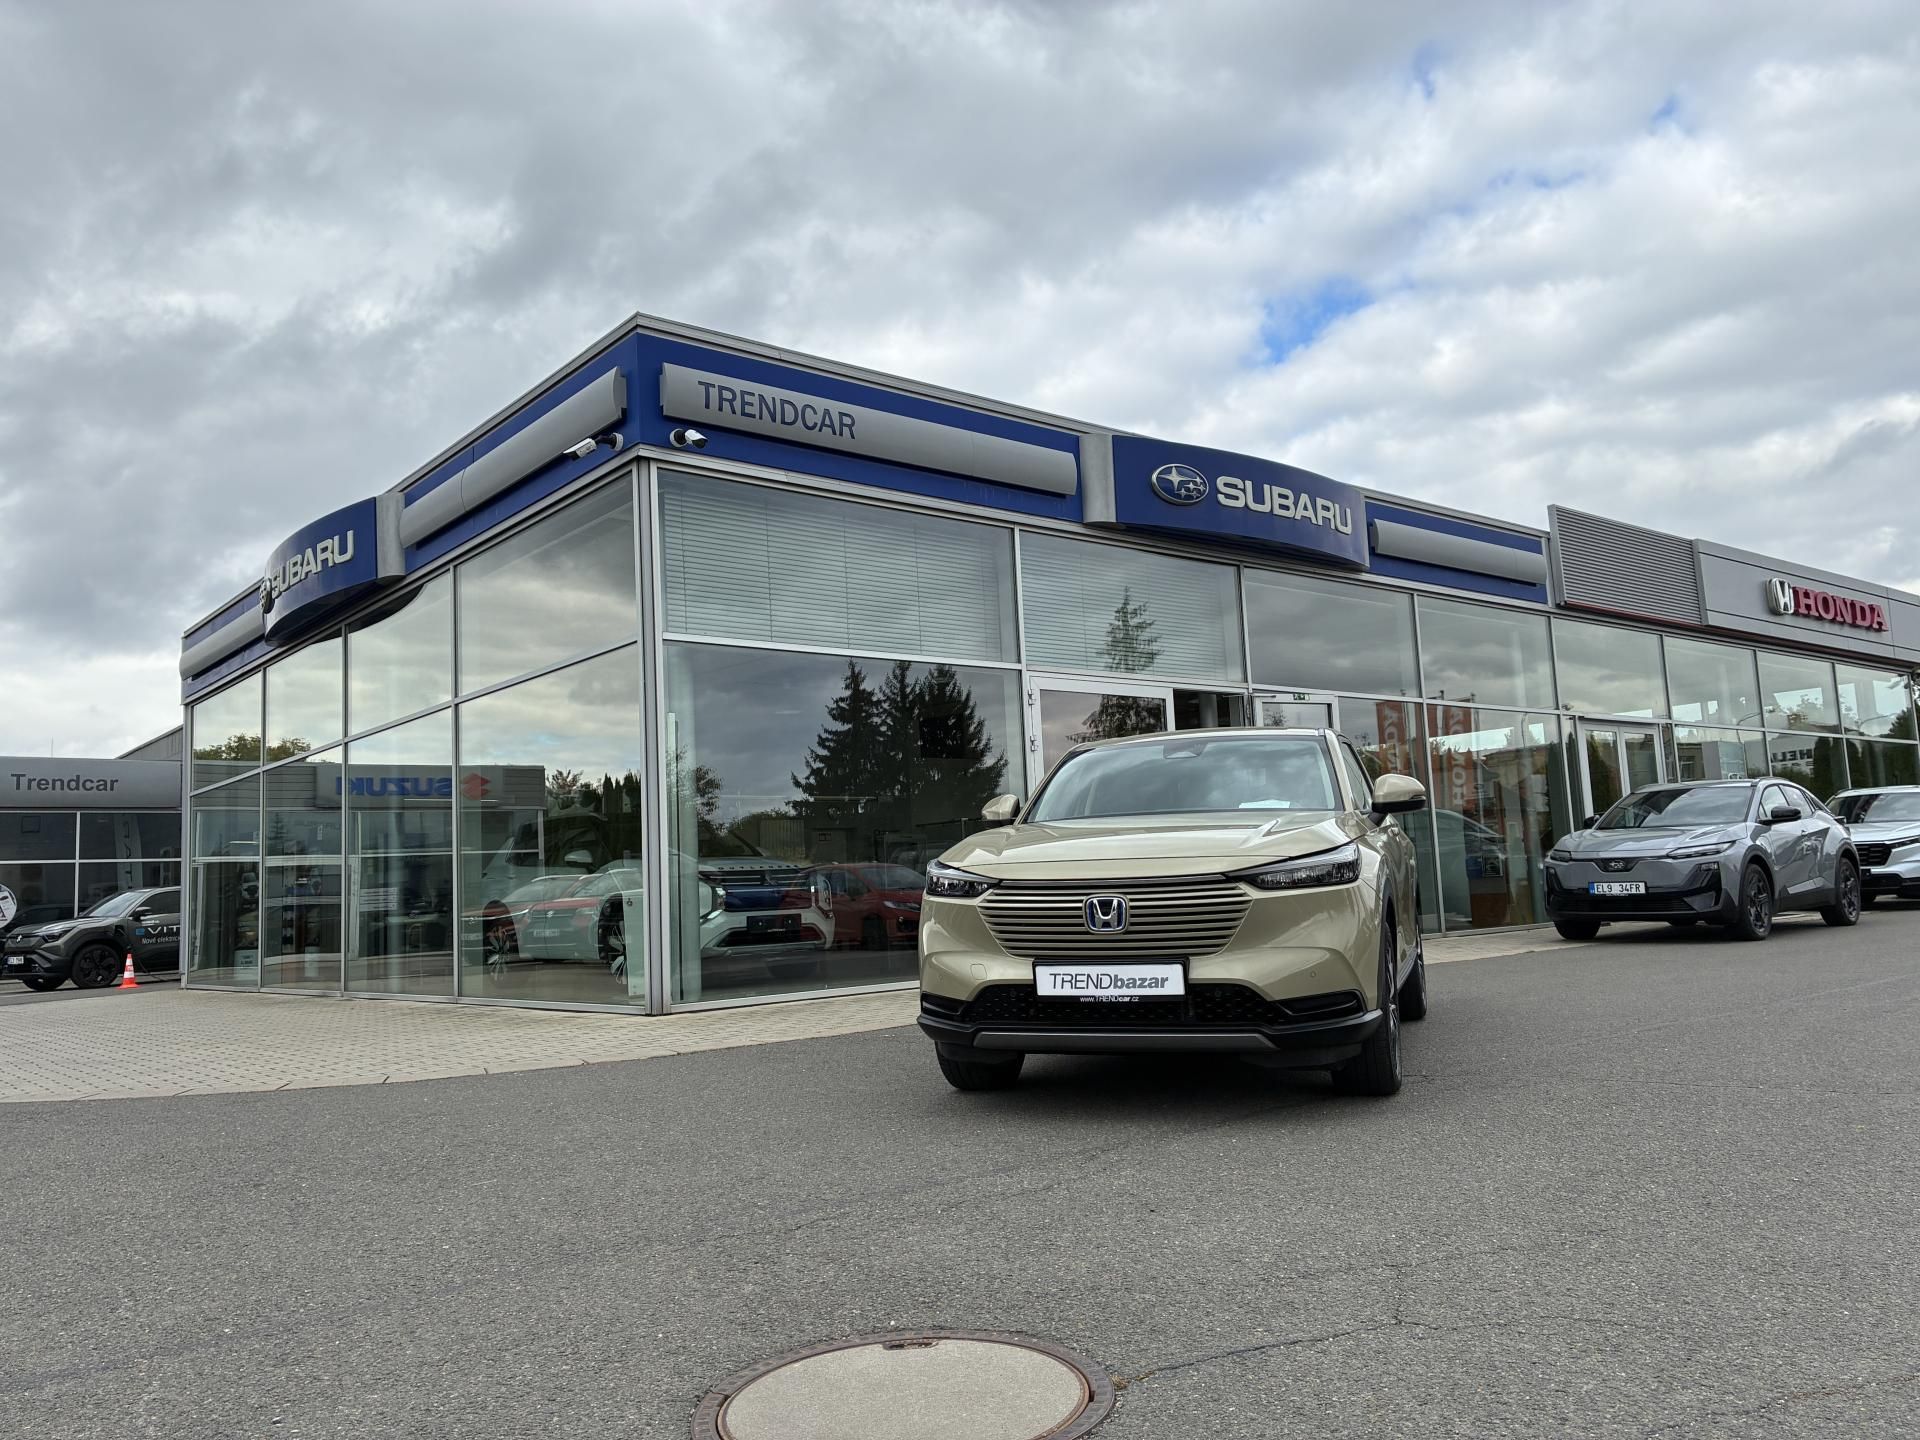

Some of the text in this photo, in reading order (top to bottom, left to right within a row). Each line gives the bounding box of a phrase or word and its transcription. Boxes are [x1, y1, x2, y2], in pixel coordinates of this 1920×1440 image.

[697, 380, 856, 440] TRENDCAR
[1216, 475, 1352, 535] SUBARU
[271, 530, 354, 600] SUBARU
[1792, 586, 1889, 632] HONDA
[10, 773, 119, 792] Trendcar
[1596, 883, 1641, 893] EL9 34FR
[1049, 973, 1169, 990] TRENDbazar
[1080, 995, 1140, 1003] www.TRENDcar.cz
